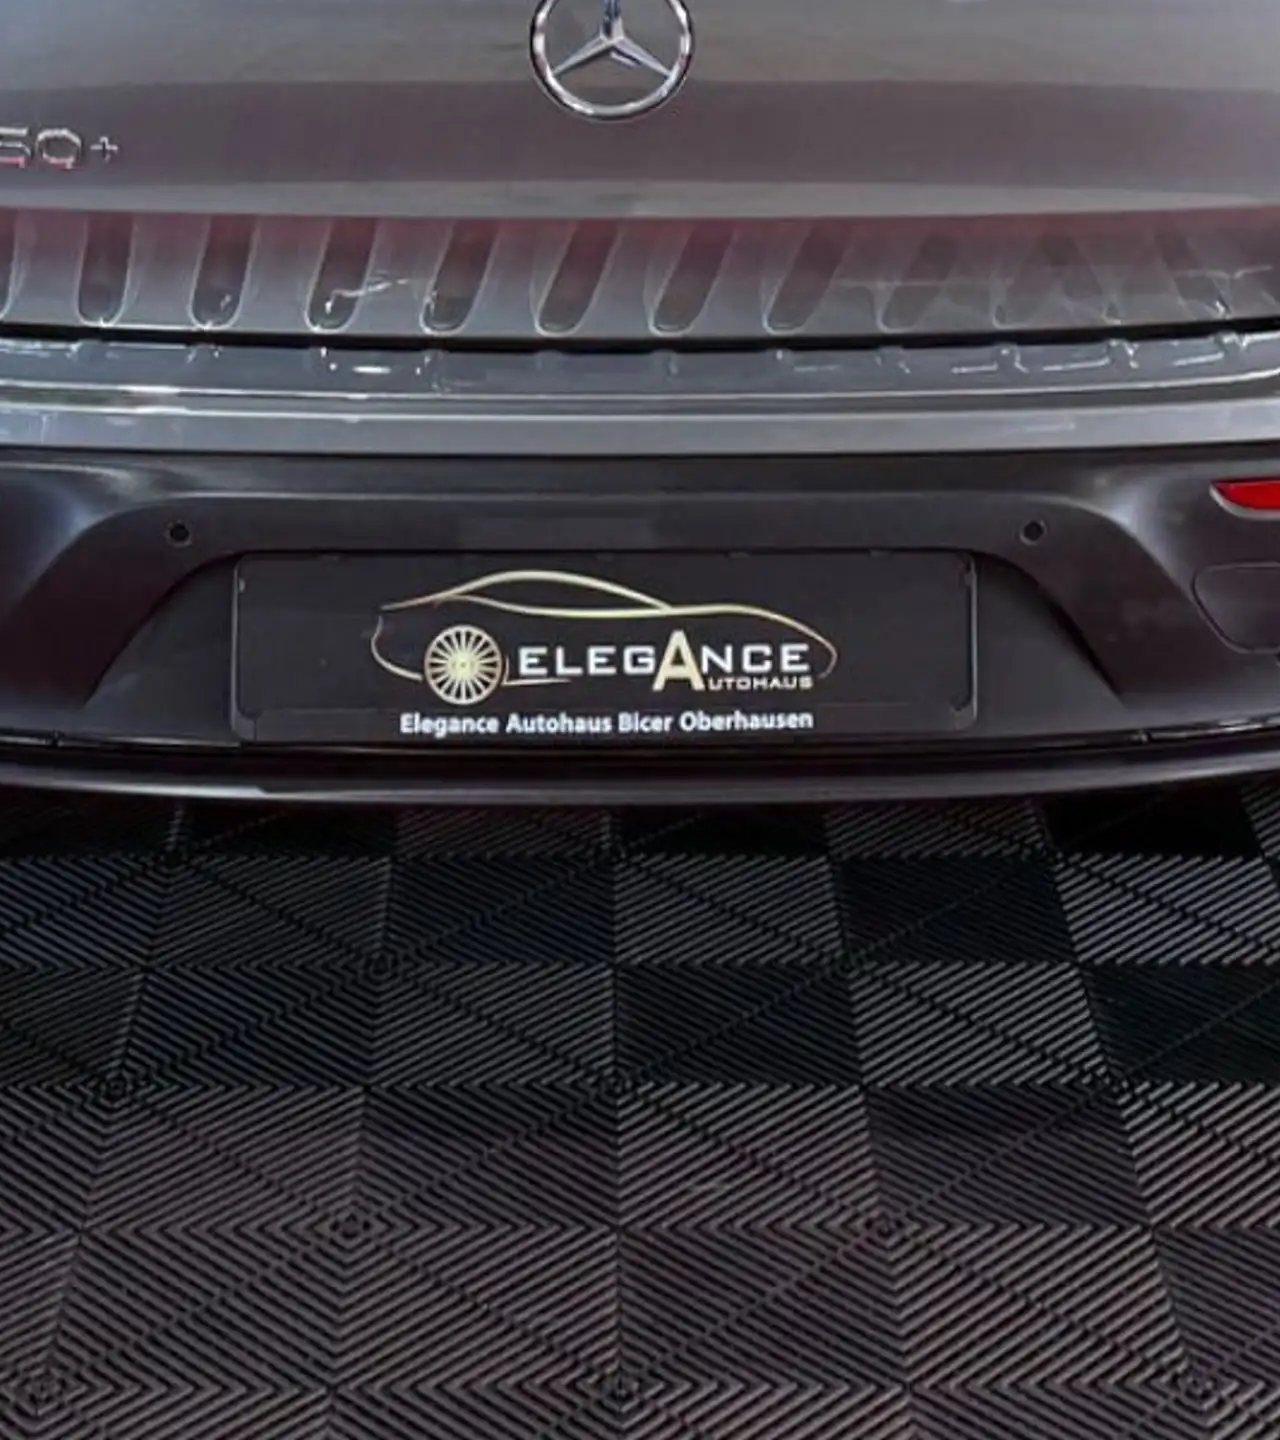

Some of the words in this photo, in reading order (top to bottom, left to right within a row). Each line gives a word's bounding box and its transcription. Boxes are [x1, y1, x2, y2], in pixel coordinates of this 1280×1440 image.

[518, 630, 810, 691] ELEGANCE
[399, 713, 500, 738] Elegance
[505, 712, 612, 734] Autohaus
[679, 710, 815, 733] Oberhausen
